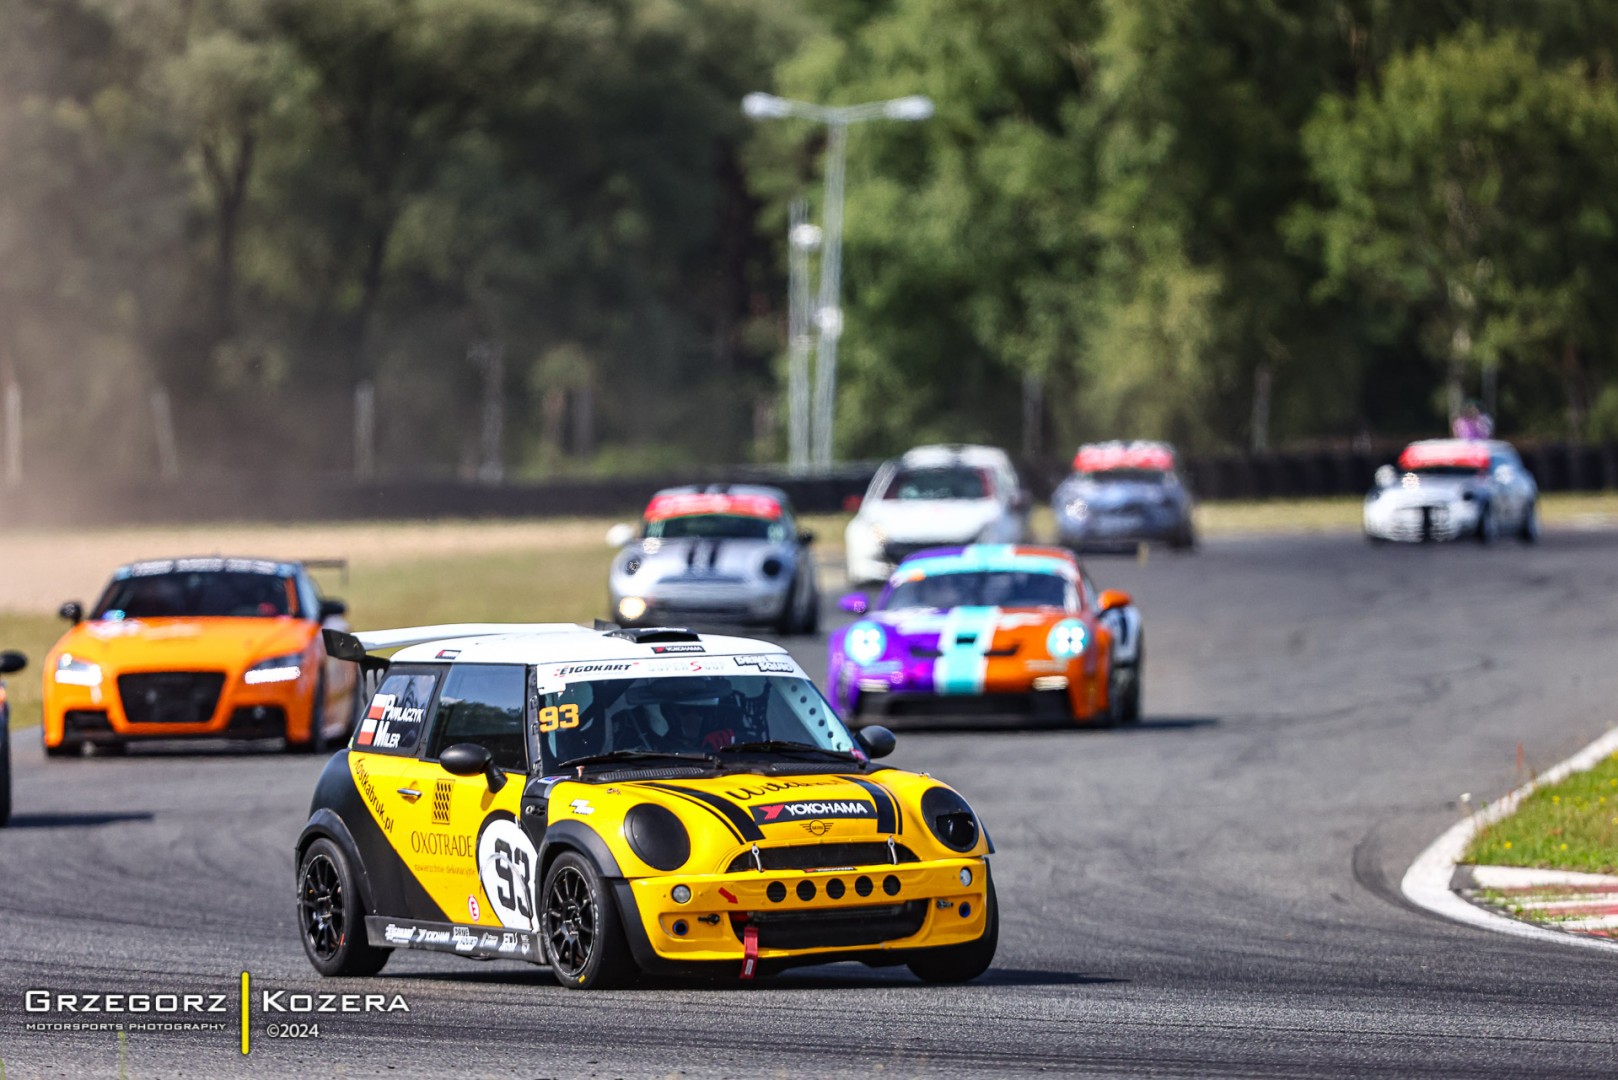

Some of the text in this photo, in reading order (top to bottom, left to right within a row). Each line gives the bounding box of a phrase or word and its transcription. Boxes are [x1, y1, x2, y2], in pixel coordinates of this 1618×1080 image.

[539, 703, 580, 733] 93
[784, 802, 868, 816] YOKOHAMA
[411, 830, 473, 857] OXOTRADE
[494, 838, 534, 920] 93
